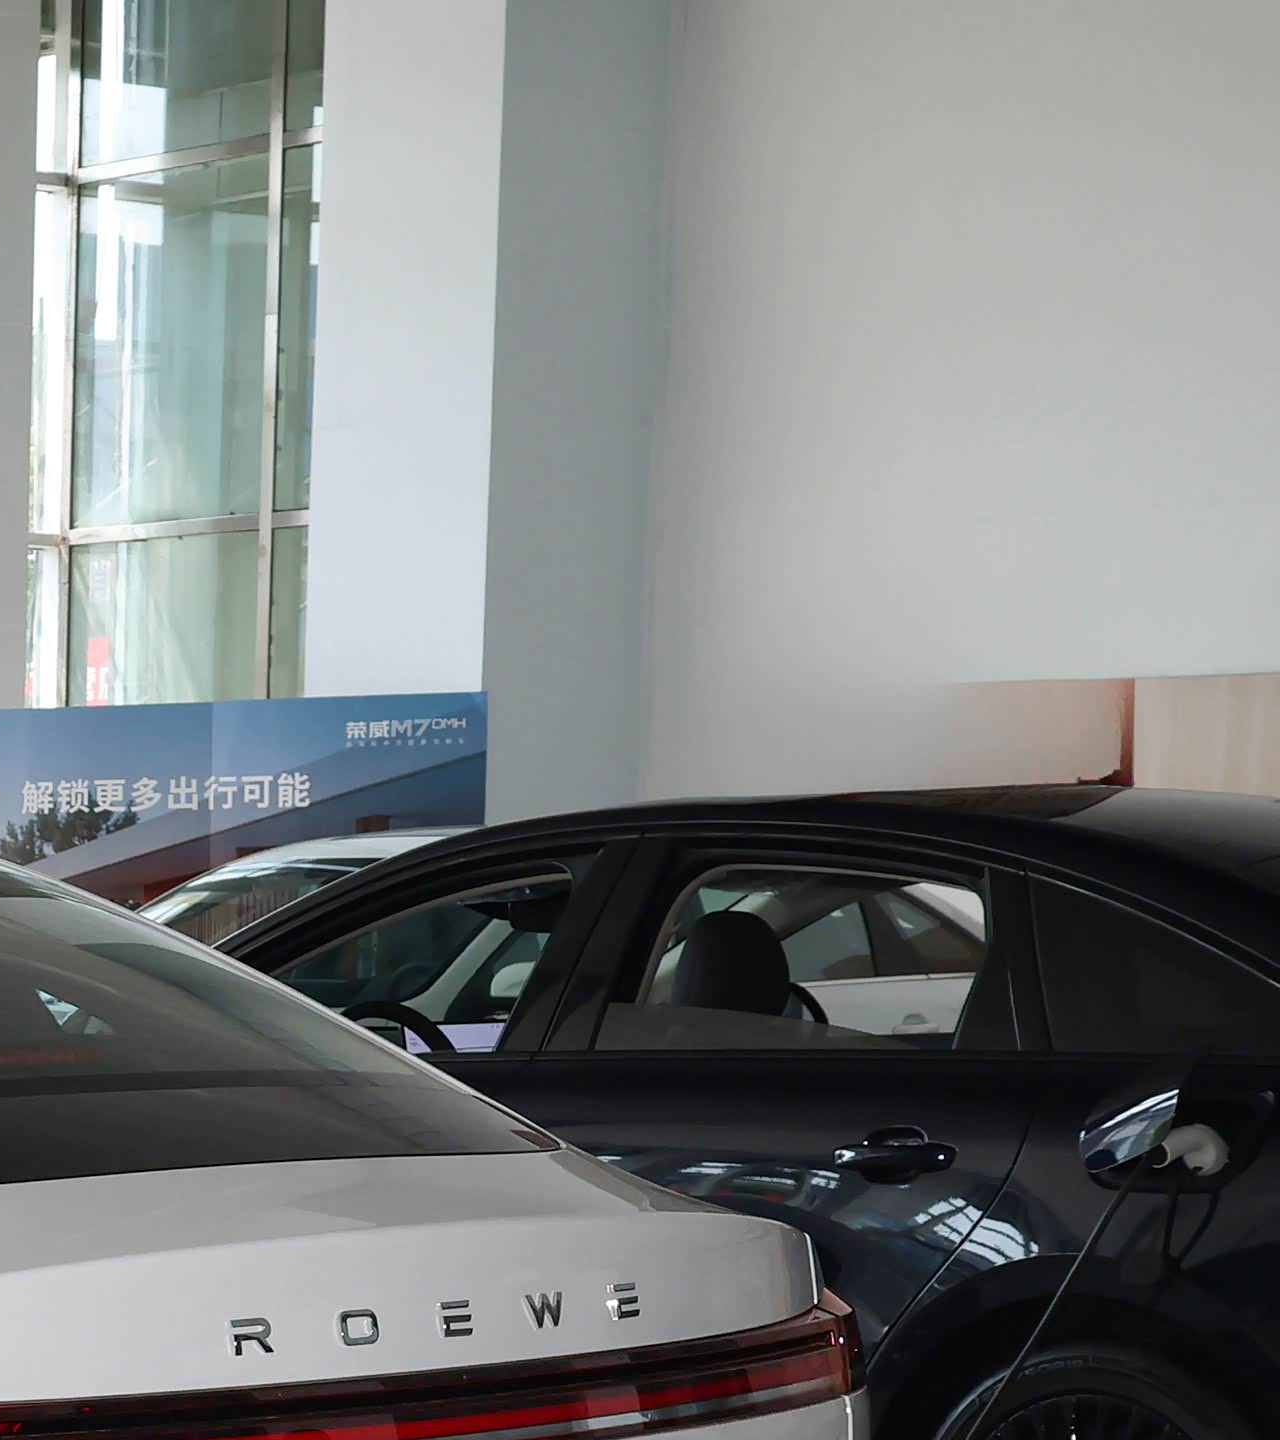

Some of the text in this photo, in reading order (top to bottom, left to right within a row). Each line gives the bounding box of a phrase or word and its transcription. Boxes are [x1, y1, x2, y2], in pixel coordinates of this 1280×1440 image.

[20, 772, 312, 815] 解锁更多出行可能
[229, 1282, 641, 1357] ROEWE
